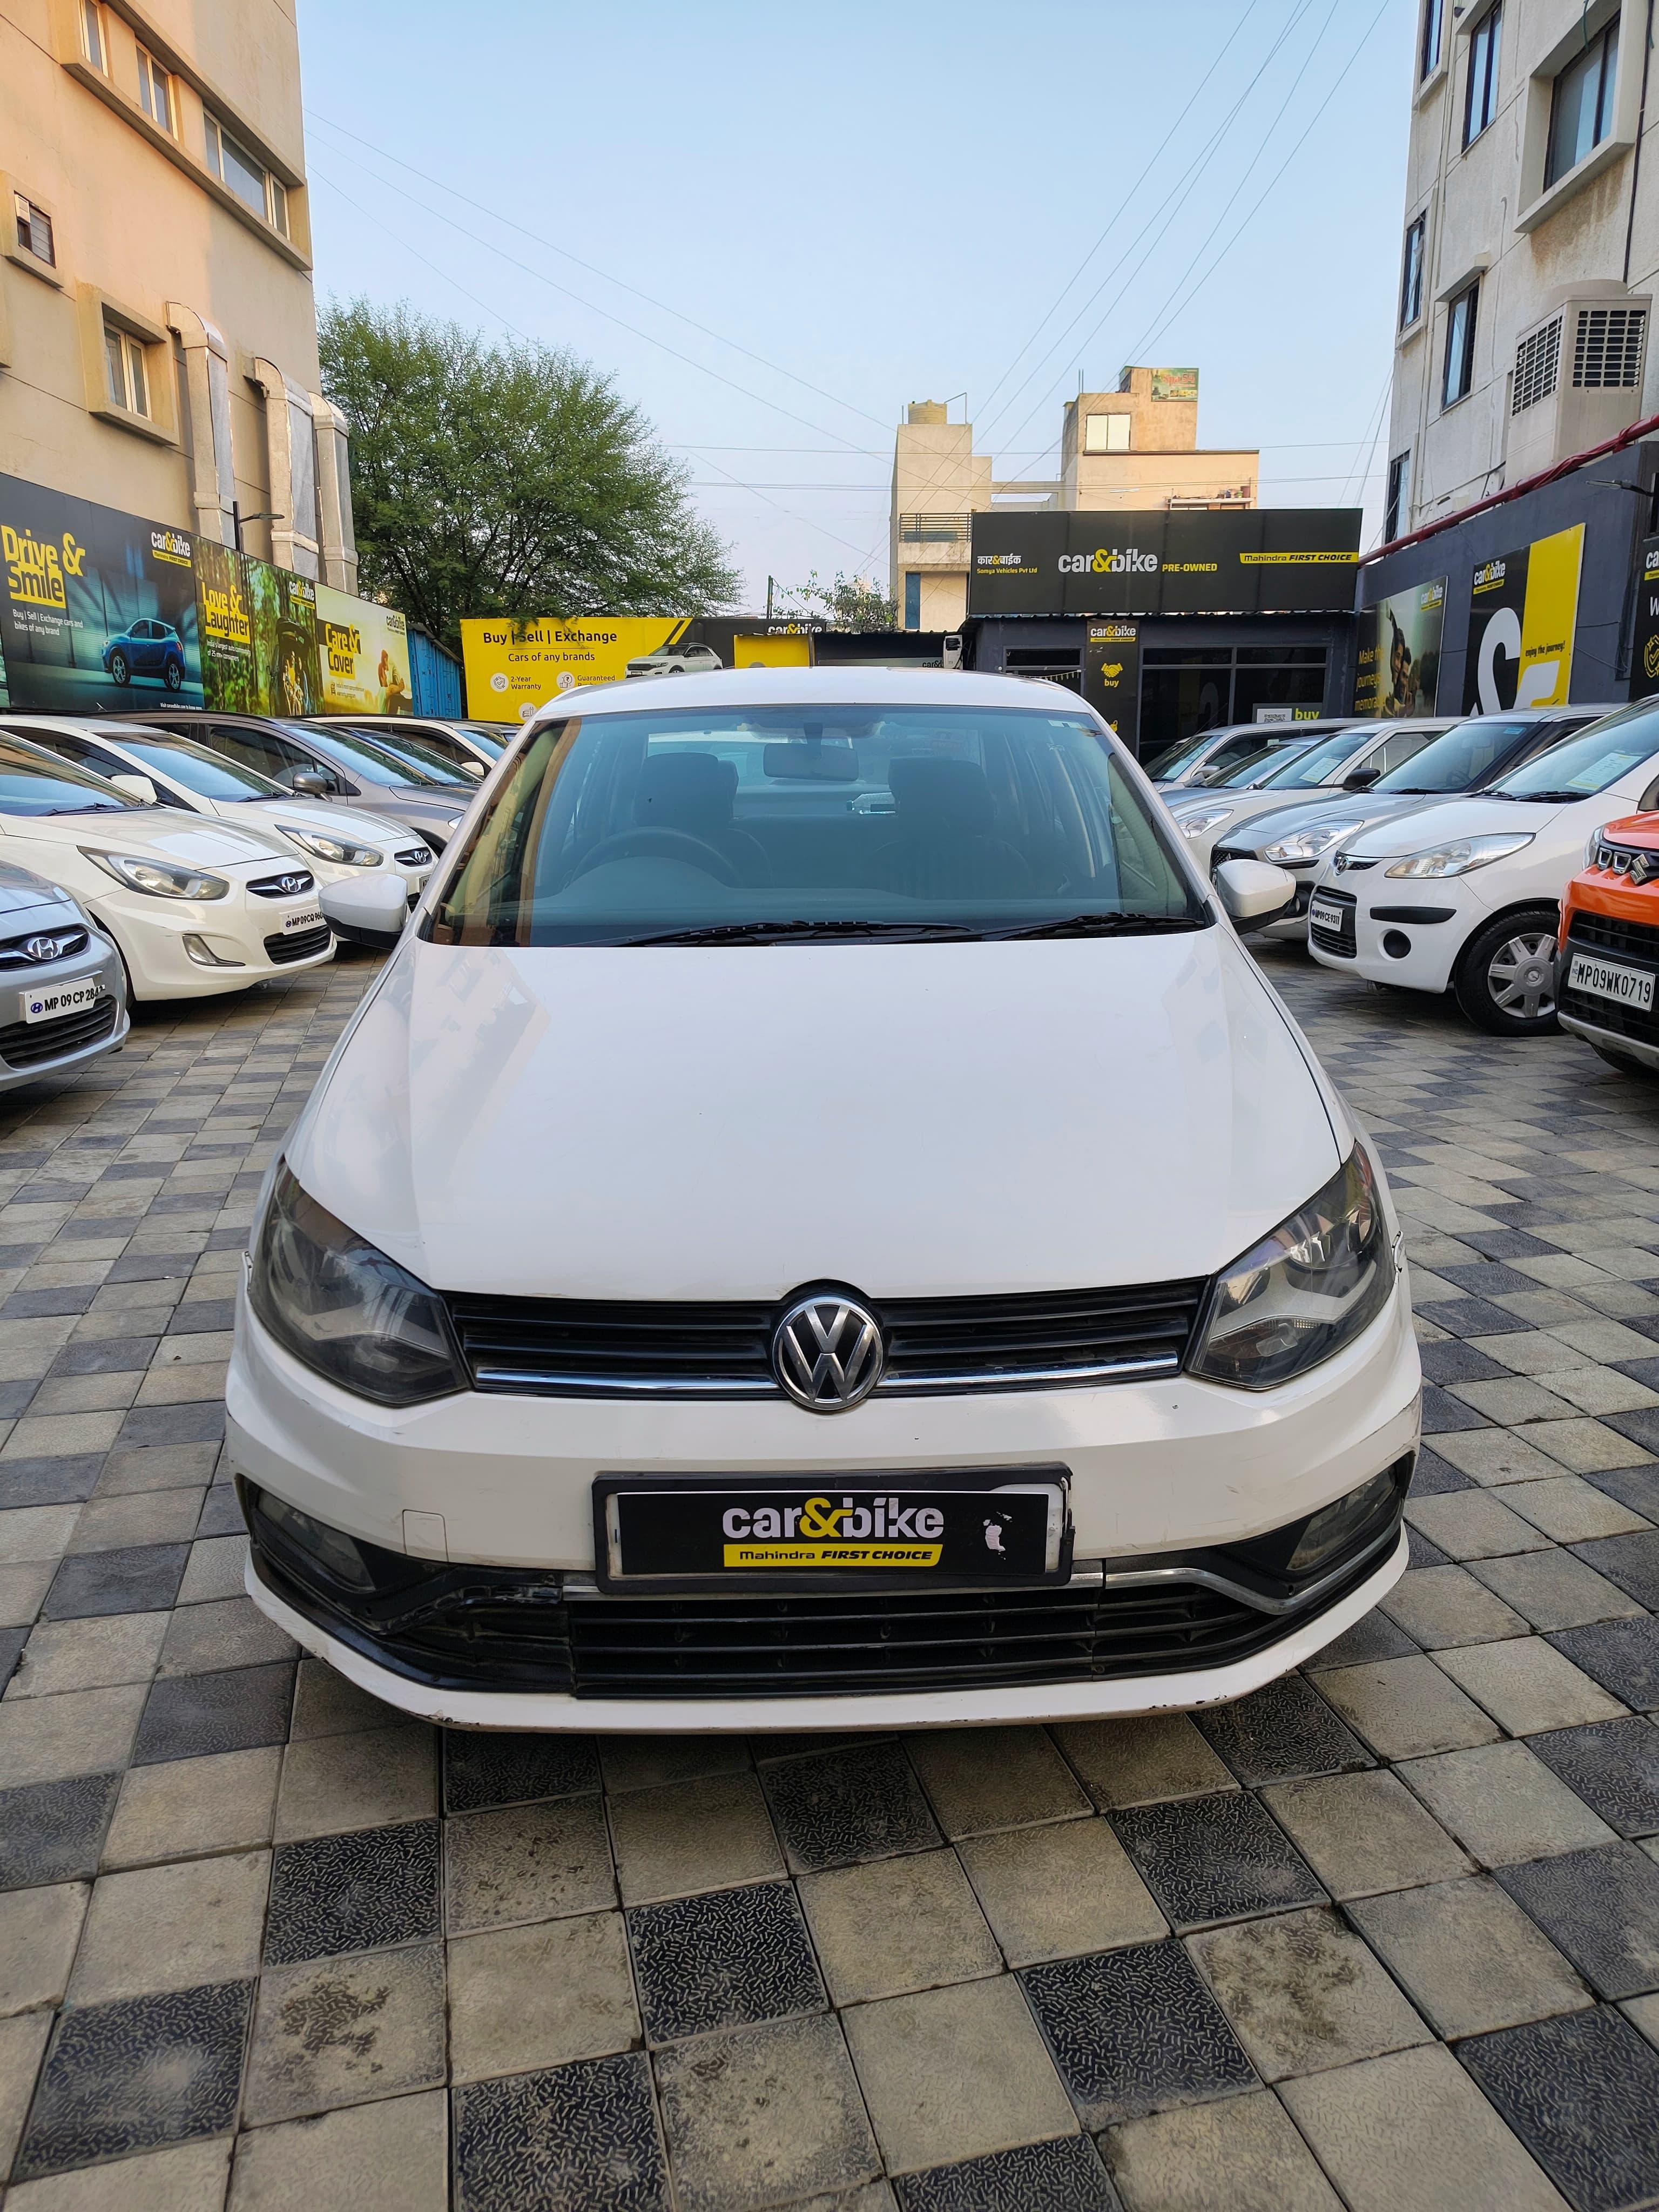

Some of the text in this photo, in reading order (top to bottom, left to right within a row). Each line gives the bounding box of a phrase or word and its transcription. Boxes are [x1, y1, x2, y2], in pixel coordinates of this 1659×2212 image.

[1, 525, 85, 576] Drive &
[151, 531, 191, 557] car&bike
[1058, 549, 1217, 572] car&bike PRE-OWNED
[8, 560, 63, 602] Smile
[1474, 560, 1505, 585] car&bike
[202, 582, 242, 614] Love &
[289, 581, 314, 601] car&bike
[12, 609, 24, 620] Buy
[27, 611, 37, 620] Sell
[40, 613, 63, 626] Exchange
[14, 621, 60, 635] bikes of any brand
[205, 605, 248, 637] Laughter
[326, 623, 360, 654] Care &
[483, 632, 507, 645] Buy
[555, 630, 617, 644] Exchange
[1090, 625, 1136, 636] car&bike
[328, 648, 353, 674] Cover
[508, 652, 595, 662] Cars of any brands
[1359, 648, 1374, 664] Make
[1104, 679, 1119, 687] buy
[1295, 708, 1319, 720] buy
[1577, 963, 1651, 1003] MP09WK0719
[44, 997, 59, 1011] MP
[60, 994, 72, 1007] 09
[73, 991, 84, 1004] CP
[723, 1497, 944, 1539] car&bike
[740, 1550, 933, 1560] Mahindra FIRST CHOICE
